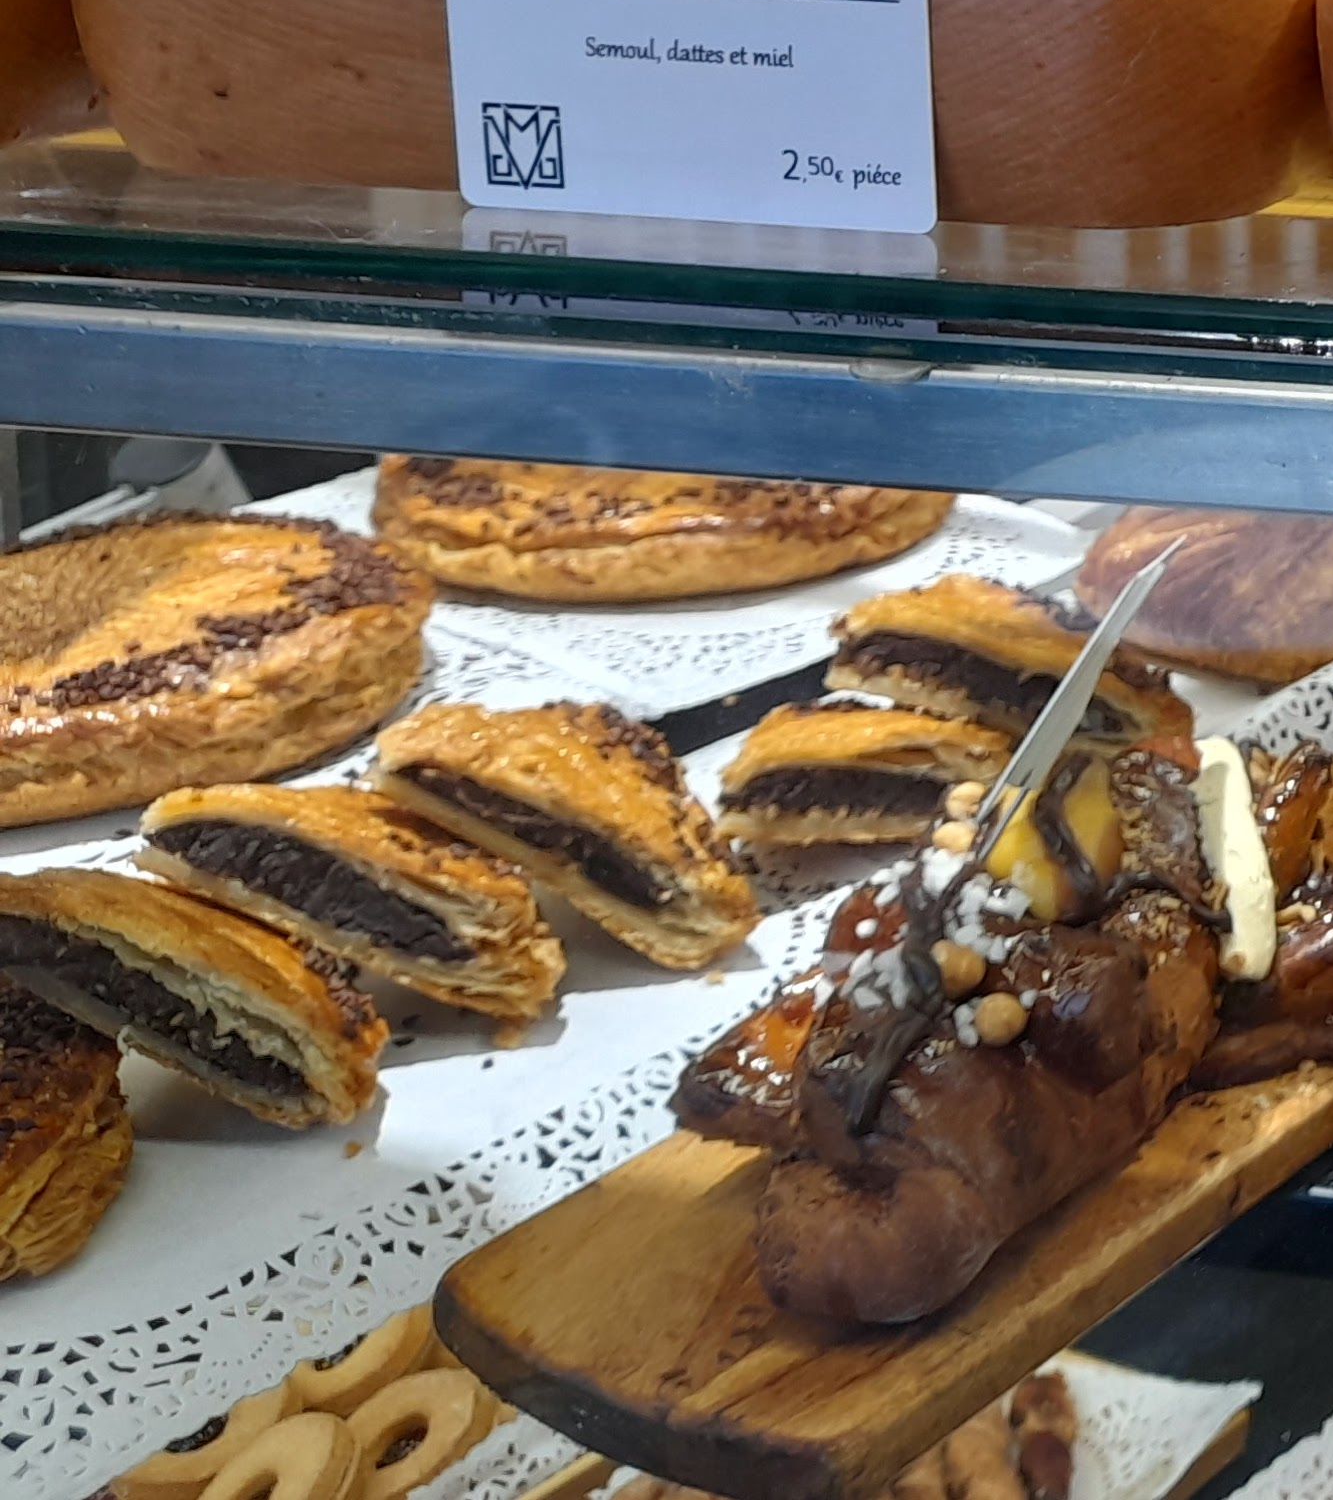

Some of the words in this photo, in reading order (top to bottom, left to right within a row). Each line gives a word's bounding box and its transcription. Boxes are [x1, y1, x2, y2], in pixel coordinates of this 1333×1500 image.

[584, 36, 662, 65] Semoul,
[666, 38, 725, 64] dattes
[729, 46, 748, 66] et
[753, 44, 794, 68] miel
[852, 163, 902, 191] piéce
